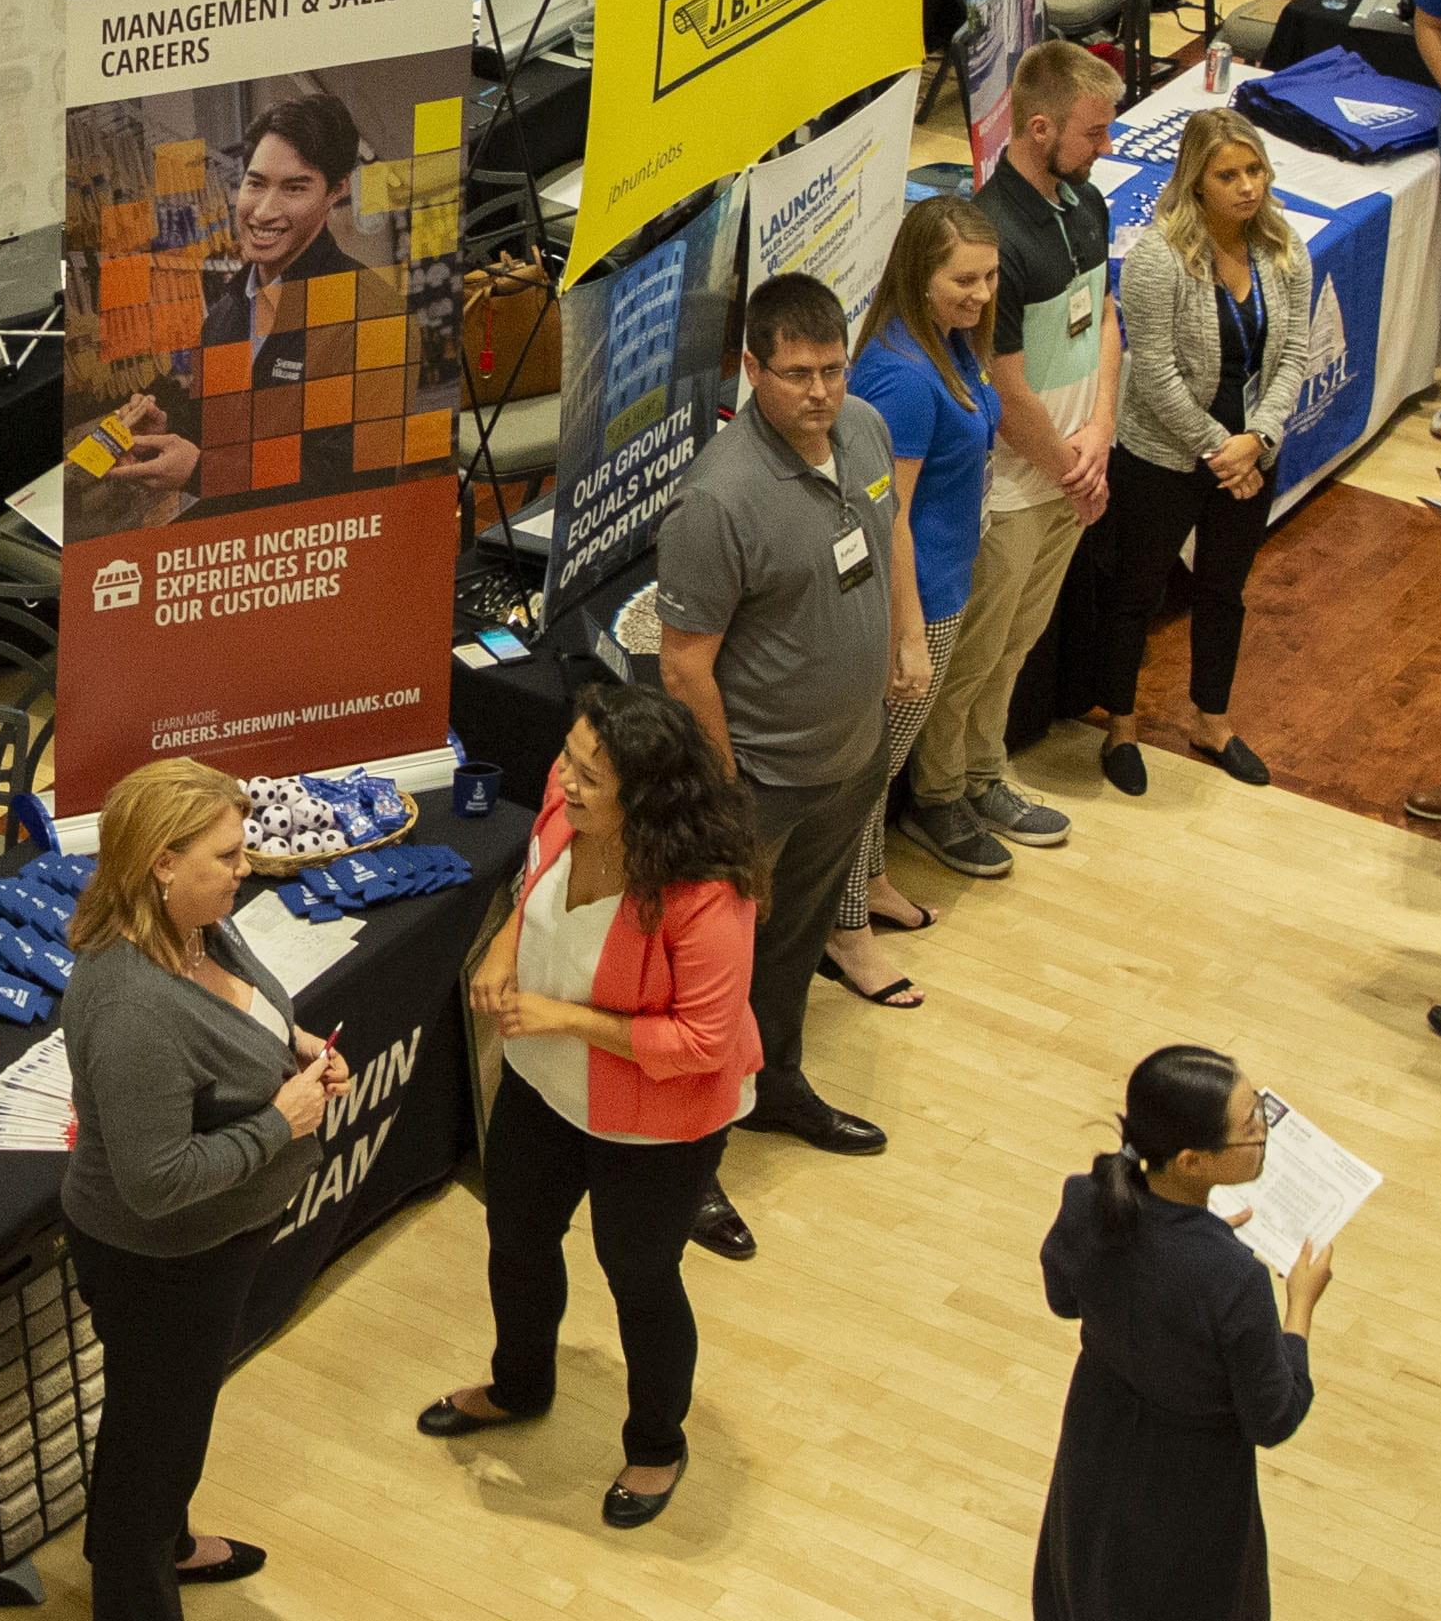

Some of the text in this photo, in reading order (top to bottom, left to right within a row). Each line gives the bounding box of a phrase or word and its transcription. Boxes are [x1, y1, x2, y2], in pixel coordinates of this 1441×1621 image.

[101, 37, 210, 78] CAREERS
[605, 140, 684, 215] jbhunt.jobs
[760, 165, 834, 248] LAUNCH
[574, 464, 609, 510] OUR
[616, 404, 692, 476] GROWTH
[568, 438, 695, 551] EQUALS YOUR
[156, 515, 382, 574] DELIVER INCREDIBLE
[559, 474, 682, 589] OPPORTUNI
[155, 574, 341, 627] OUR CUSTOMERS
[156, 548, 348, 602] EXPERIENCES FOR
[152, 687, 421, 751] CAREERS.SHERWIN-WILLIAMS.COM
[152, 710, 219, 732] LEARN MORE:
